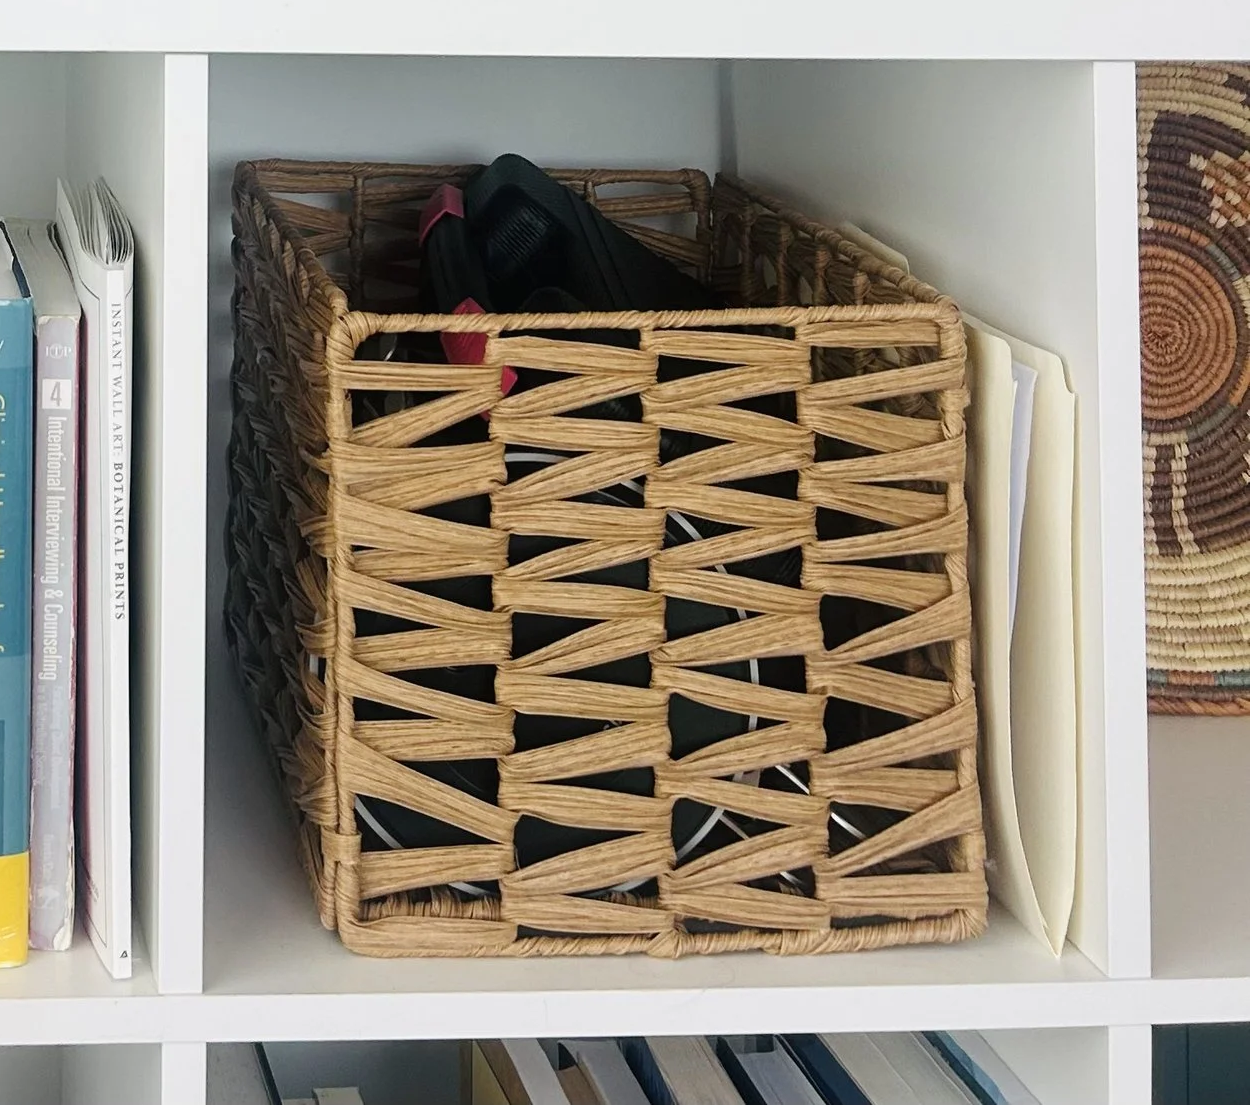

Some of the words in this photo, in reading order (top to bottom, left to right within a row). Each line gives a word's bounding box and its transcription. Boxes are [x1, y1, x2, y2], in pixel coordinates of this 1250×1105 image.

[111, 303, 122, 370] INSTANT
[50, 381, 63, 407] 4
[112, 376, 123, 420] WALL
[46, 417, 67, 493] Intentional
[112, 422, 123, 456] ART:
[39, 496, 66, 584] Interviewing
[113, 462, 125, 556] BOTANICAL
[44, 589, 63, 599] &
[114, 562, 125, 620] PRINTS
[38, 604, 63, 681] Counseling
